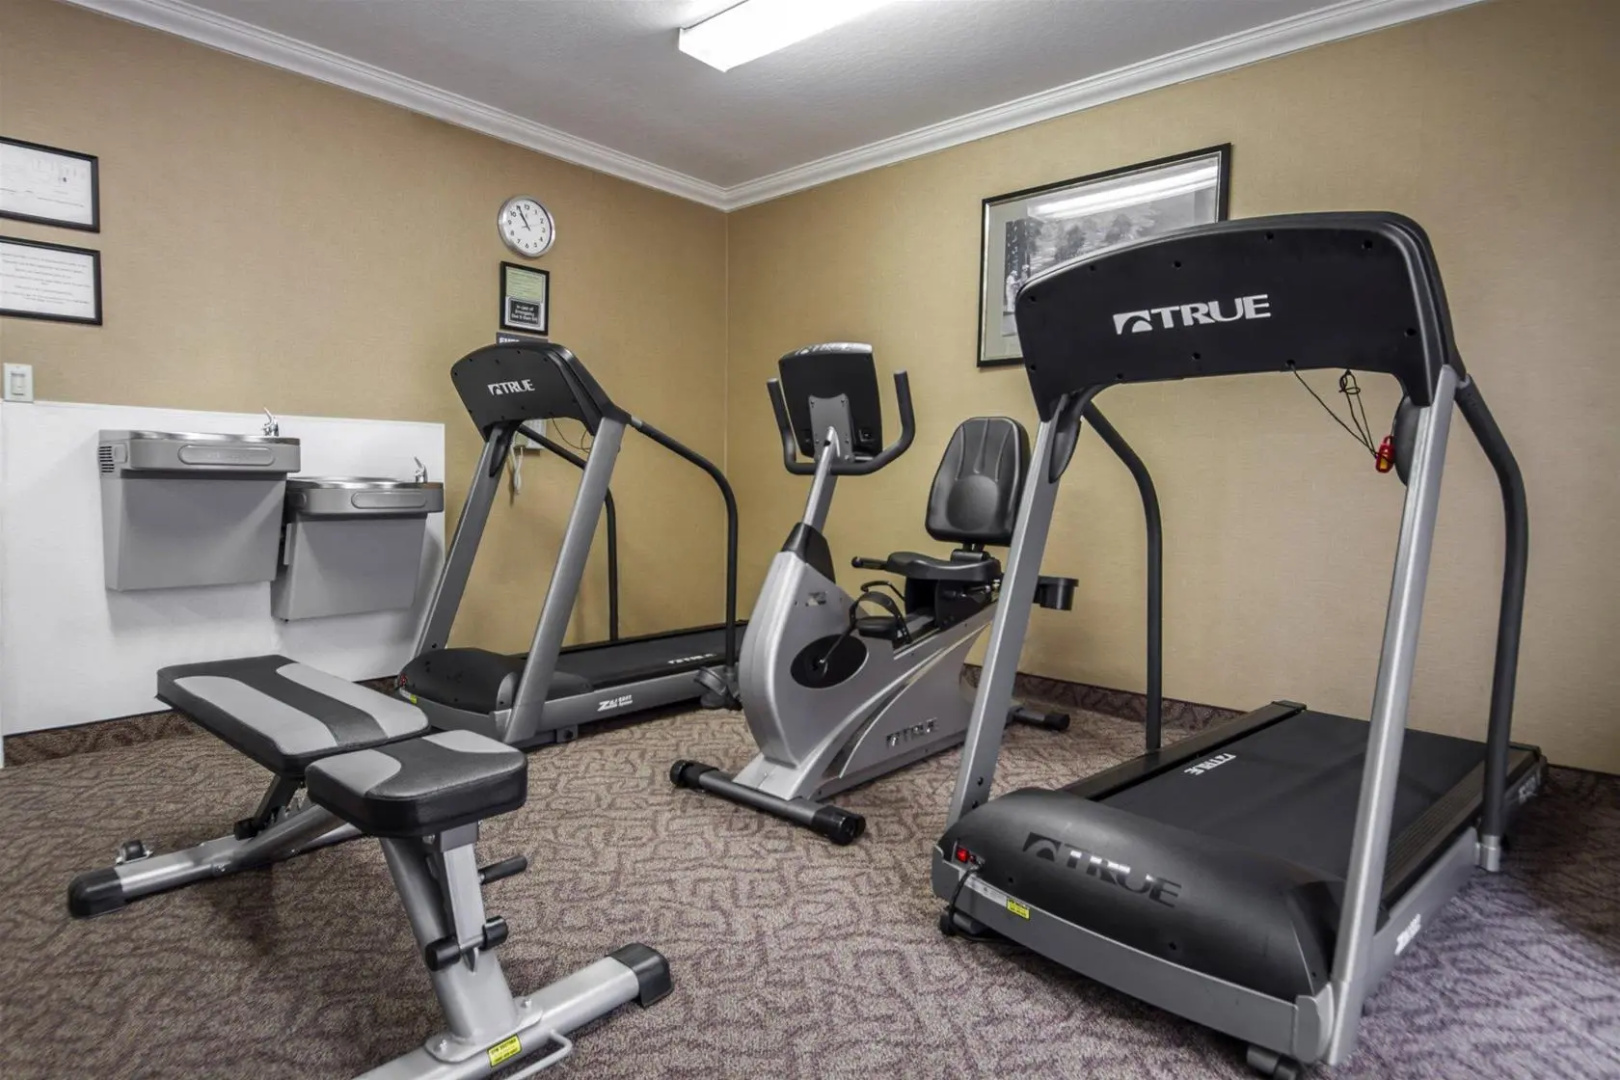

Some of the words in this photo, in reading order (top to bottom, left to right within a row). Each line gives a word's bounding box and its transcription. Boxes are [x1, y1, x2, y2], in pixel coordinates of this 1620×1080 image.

[1151, 294, 1271, 329] TRUE
[500, 379, 536, 394] TRUE
[902, 716, 939, 742] TRUE
[1183, 757, 1226, 776] TRUE
[1065, 843, 1182, 908] TRUE
